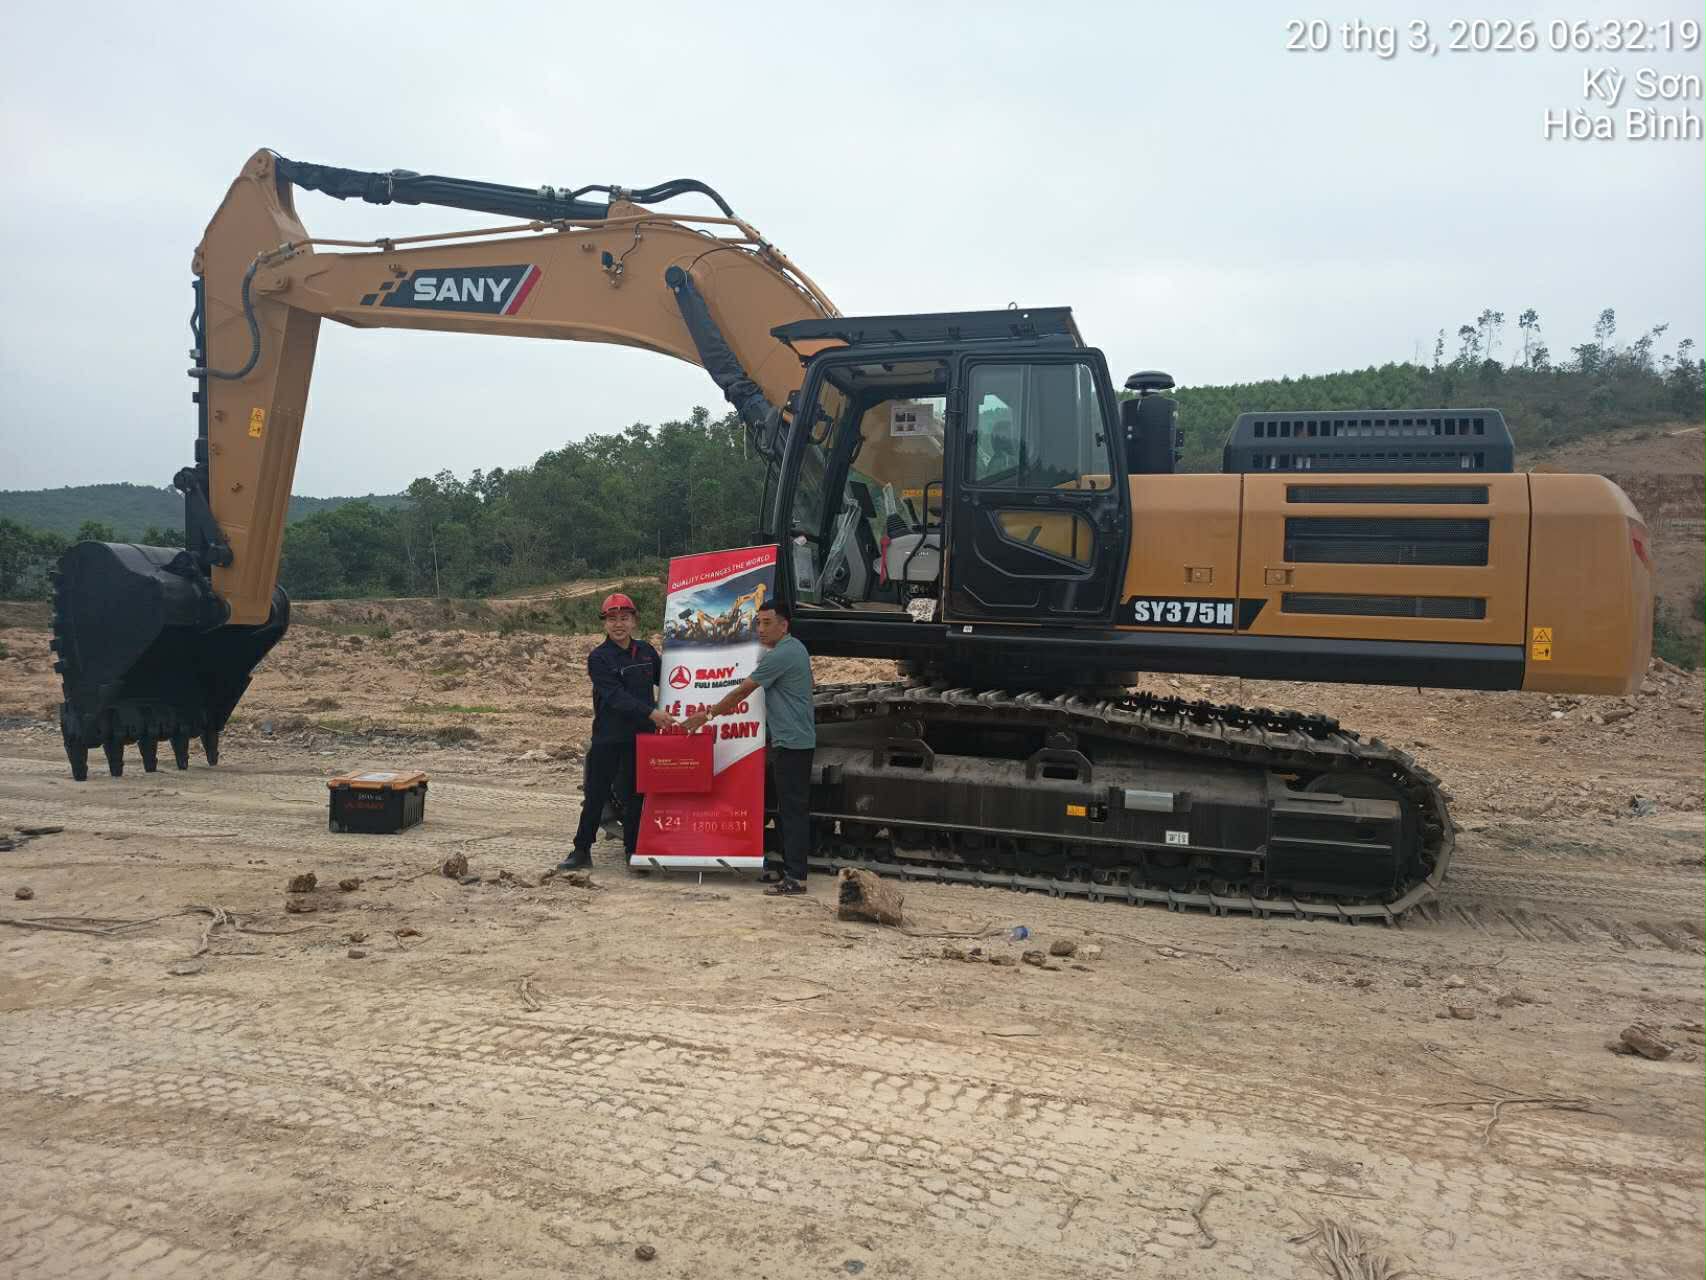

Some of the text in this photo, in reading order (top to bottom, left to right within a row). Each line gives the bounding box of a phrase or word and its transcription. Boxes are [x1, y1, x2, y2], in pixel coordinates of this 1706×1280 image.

[413, 276, 511, 303] SANY
[672, 554, 770, 589] QUALITY CHANGES THE WORLD
[1134, 600, 1234, 625] SY375H
[695, 667, 735, 680] SANY
[720, 722, 760, 740] SANY
